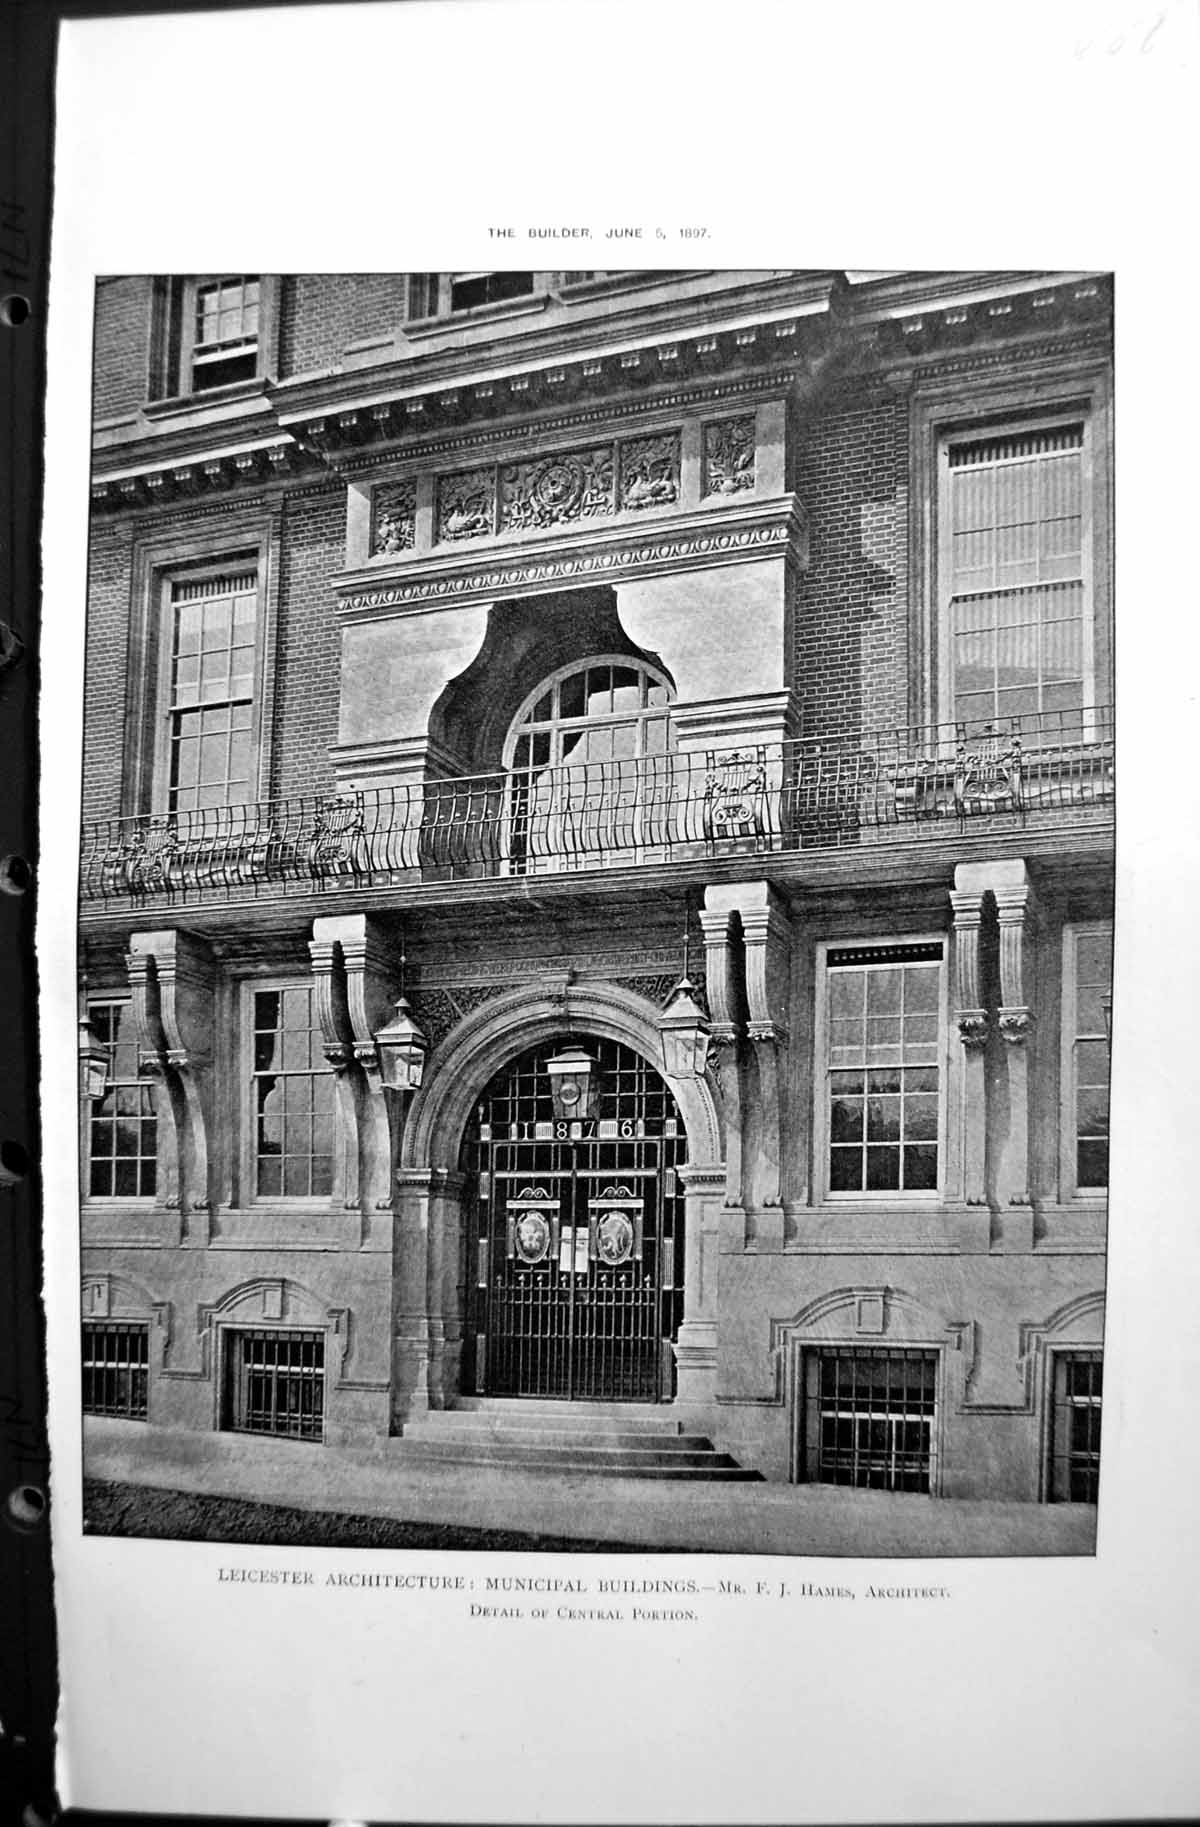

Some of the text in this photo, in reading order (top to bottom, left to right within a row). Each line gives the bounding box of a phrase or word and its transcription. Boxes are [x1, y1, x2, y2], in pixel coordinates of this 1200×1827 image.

[487, 227, 516, 239] THE
[528, 227, 594, 240] BUILDER,
[605, 227, 643, 240] JUNE
[679, 227, 712, 240] 1897.
[218, 1567, 314, 1585] LEICESTER
[486, 1577, 588, 1593] MUNICIPAL
[755, 1581, 770, 1595] F.
[779, 1582, 791, 1599] J.
